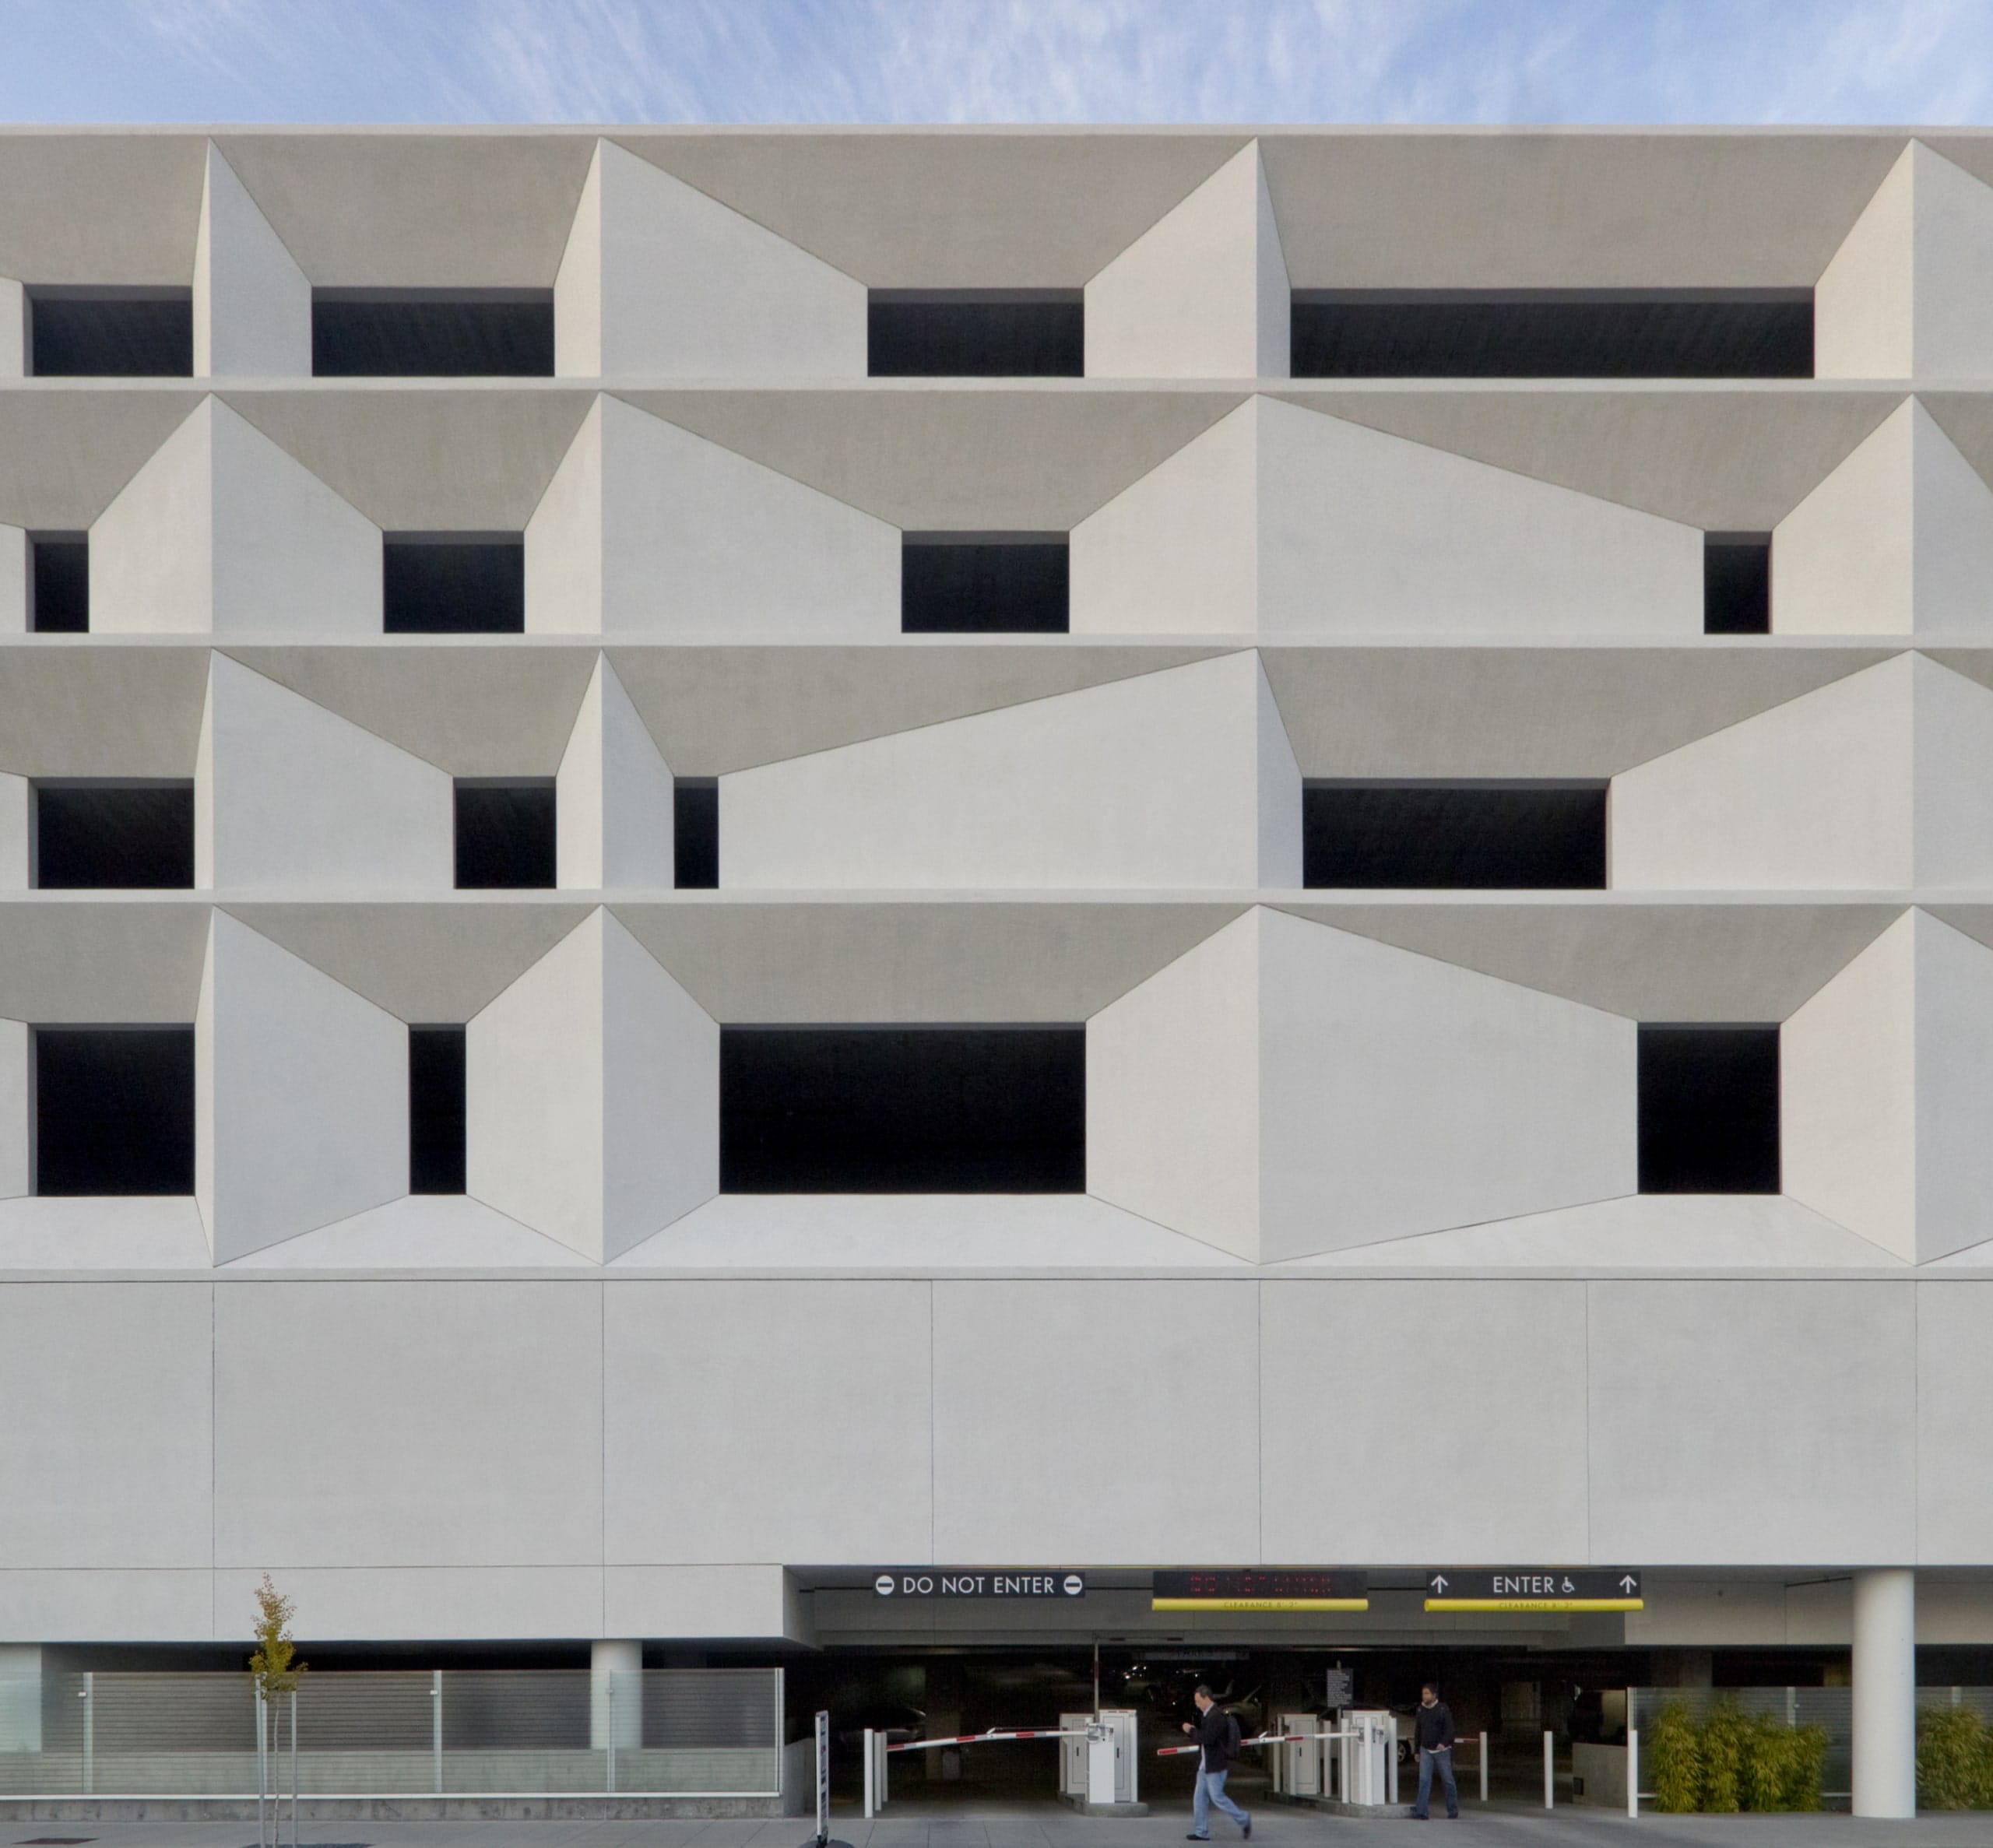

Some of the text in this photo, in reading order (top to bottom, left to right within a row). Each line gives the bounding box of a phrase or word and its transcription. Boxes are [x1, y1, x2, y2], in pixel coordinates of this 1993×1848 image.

[903, 1576, 1054, 1593] DO NOT ENTER
[1492, 1576, 1555, 1593] ENTER
